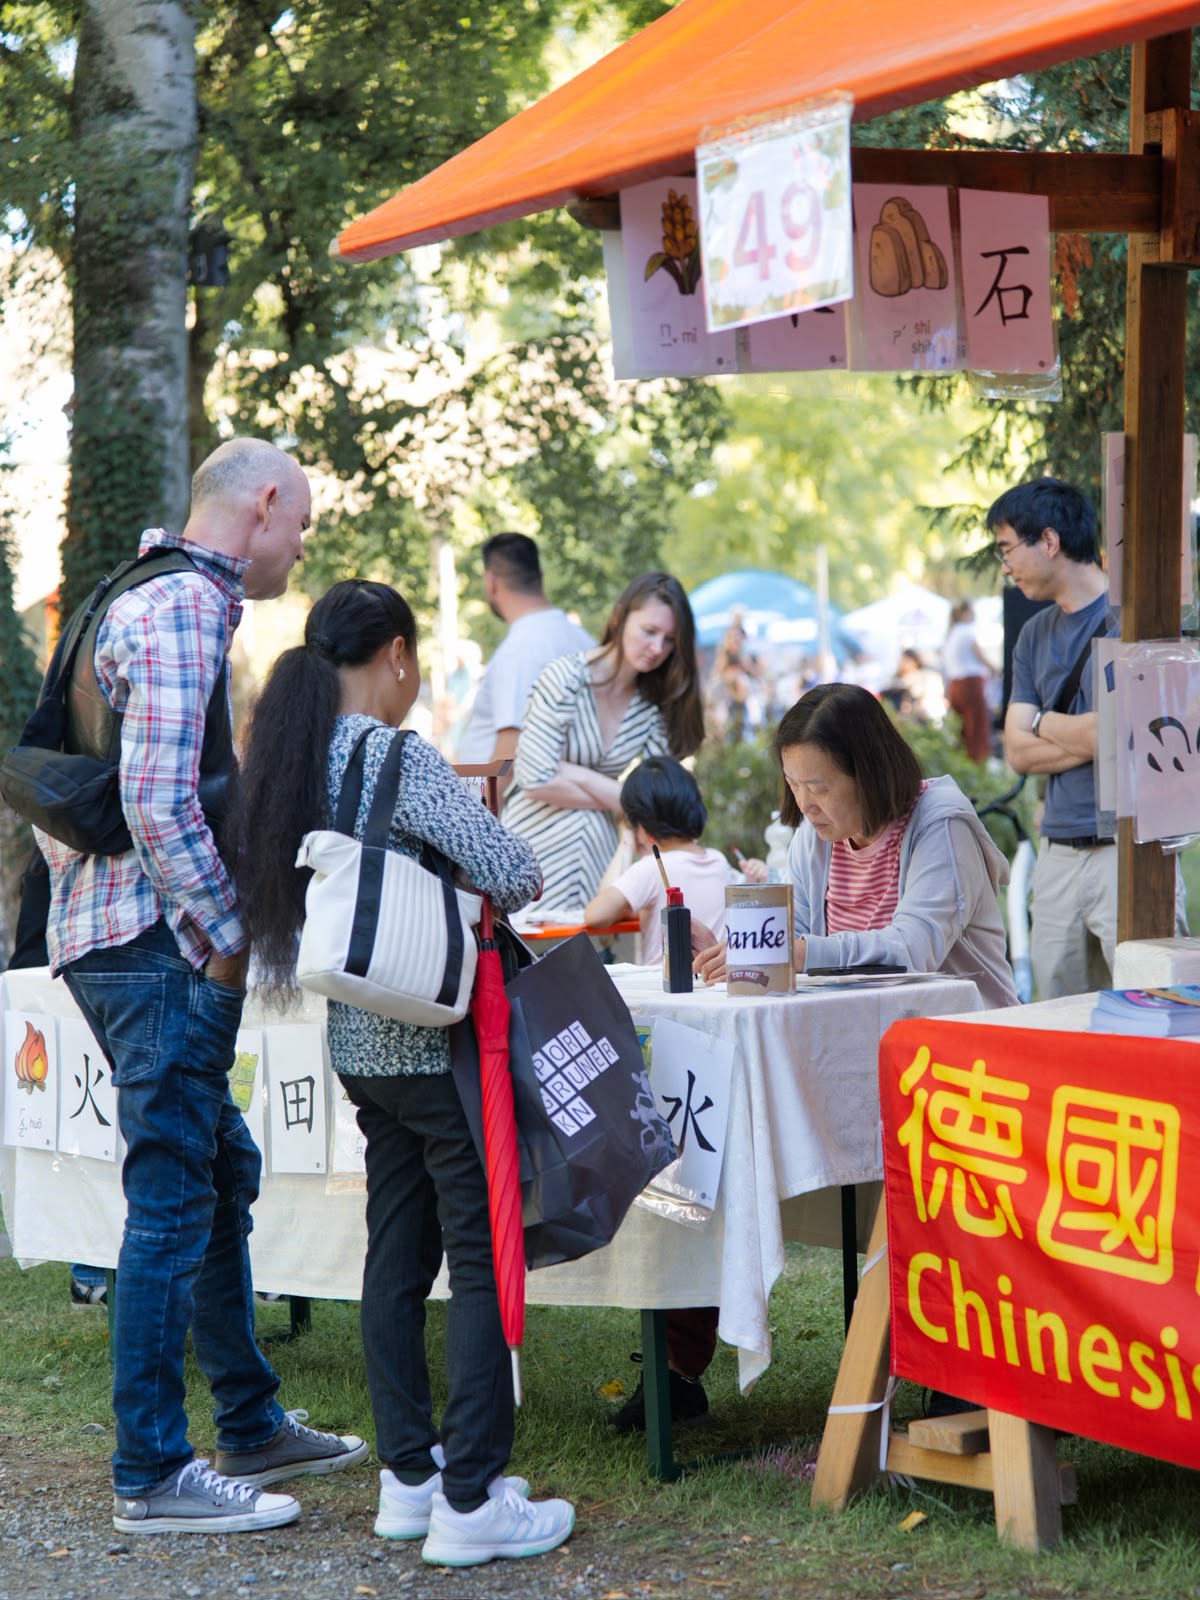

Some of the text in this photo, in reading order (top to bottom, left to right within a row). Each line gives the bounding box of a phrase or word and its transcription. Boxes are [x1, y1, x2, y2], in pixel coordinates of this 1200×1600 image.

[732, 179, 822, 281] 49
[974, 246, 1033, 327] 石
[69, 1053, 111, 1127] 火
[280, 1074, 315, 1133] 田
[662, 1069, 717, 1153] 水
[898, 1045, 1200, 1296] 德國
[907, 1251, 1200, 1420] Chinesi
